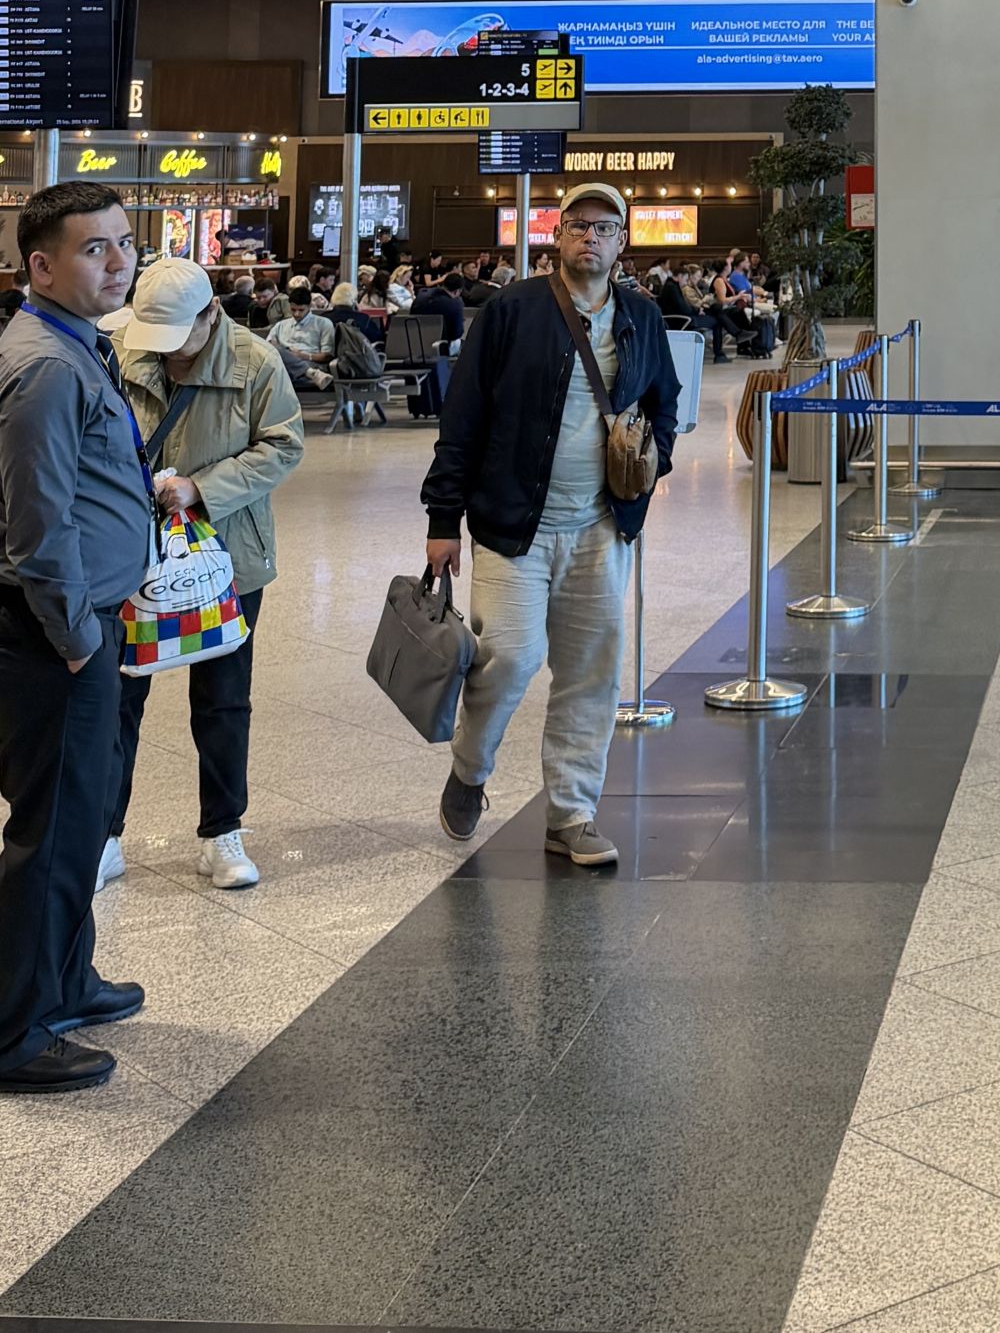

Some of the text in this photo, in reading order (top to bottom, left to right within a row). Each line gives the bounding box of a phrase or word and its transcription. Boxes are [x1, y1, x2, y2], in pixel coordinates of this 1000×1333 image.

[691, 20, 826, 30] ИДЕАЛЬНОЕ МЕСТО ДЛЯ
[836, 20, 875, 29] THE BE
[629, 35, 664, 44] ОРЫН
[709, 32, 809, 43] ВАШЕЙ РЕКЛАМЫ
[831, 33, 862, 42] YOUR
[696, 54, 823, 64] ala-advertising@tav.aero
[521, 63, 530, 77] 5
[479, 83, 530, 97] 1-2-3-4
[77, 149, 117, 172] Beer
[160, 149, 207, 177] Coffee
[564, 152, 675, 171] WORRY BEER HAPPY
